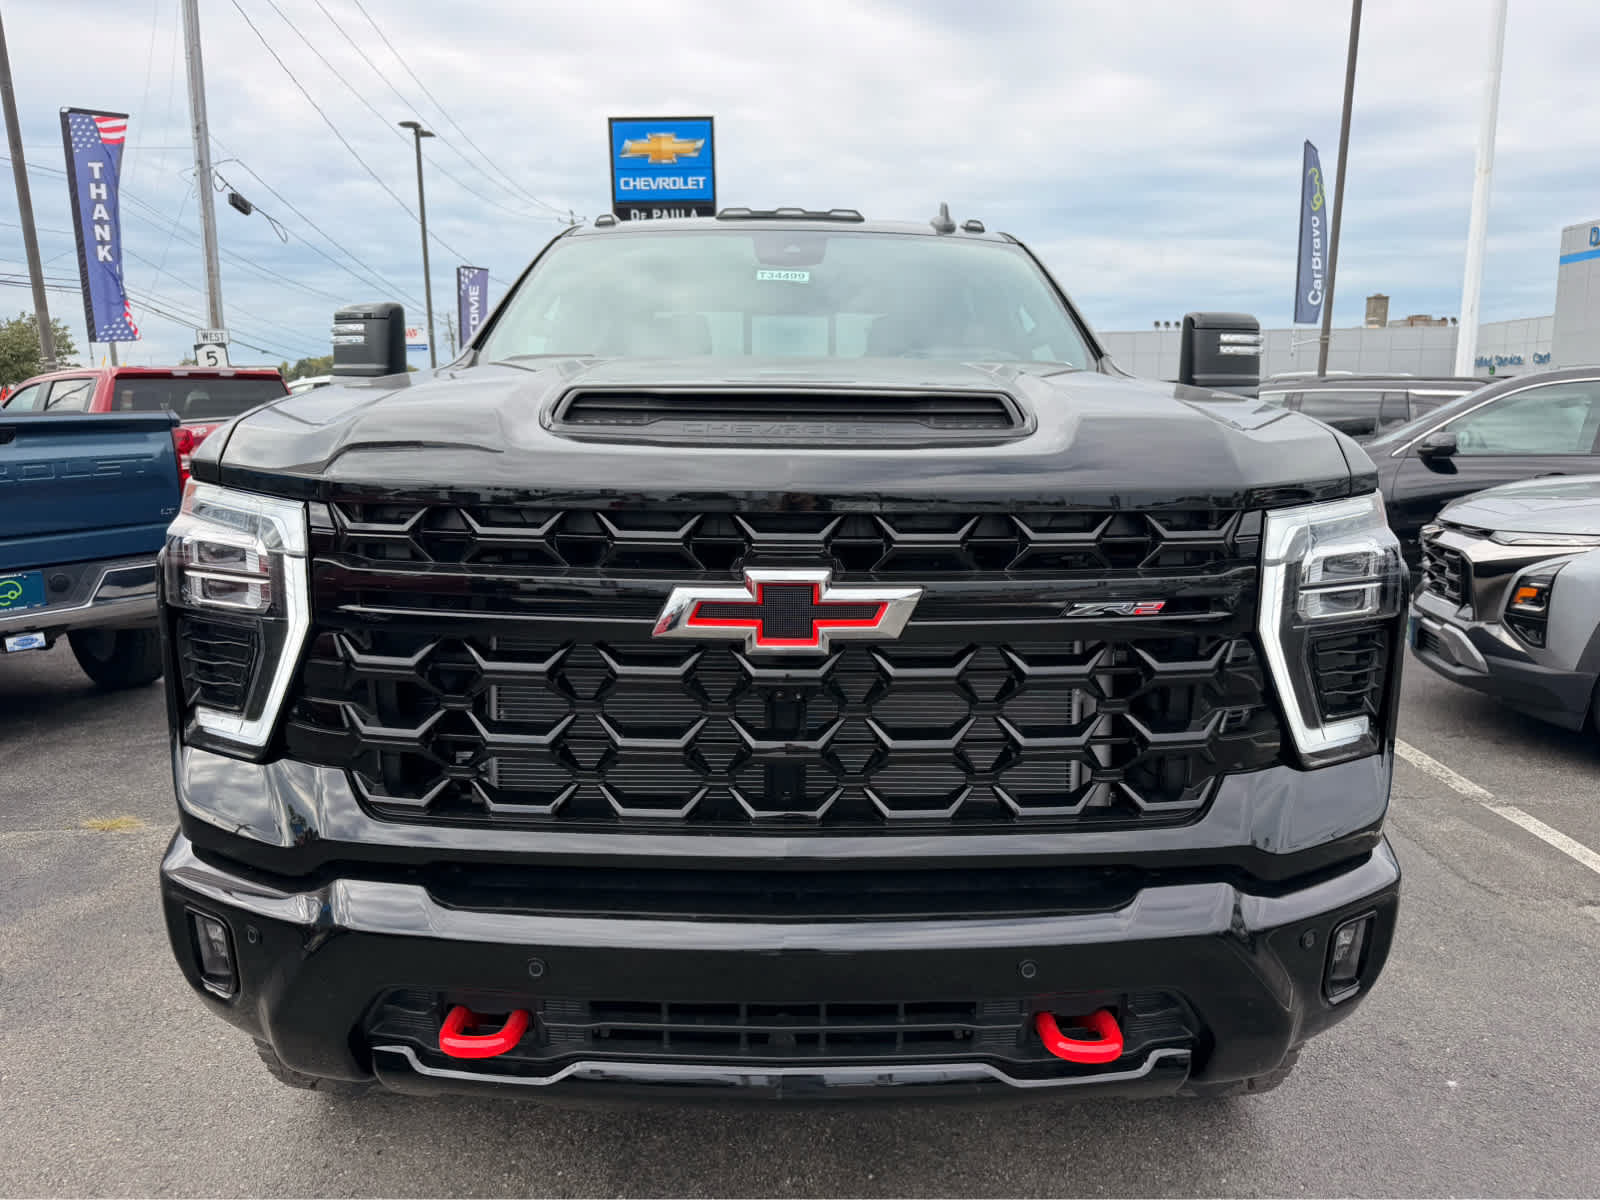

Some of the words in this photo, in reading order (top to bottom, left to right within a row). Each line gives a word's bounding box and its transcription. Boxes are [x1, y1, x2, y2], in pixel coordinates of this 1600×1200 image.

[620, 176, 706, 190] CHEVROLET
[87, 162, 113, 262] THANK
[201, 333, 225, 341] WEST
[206, 351, 218, 367] 5
